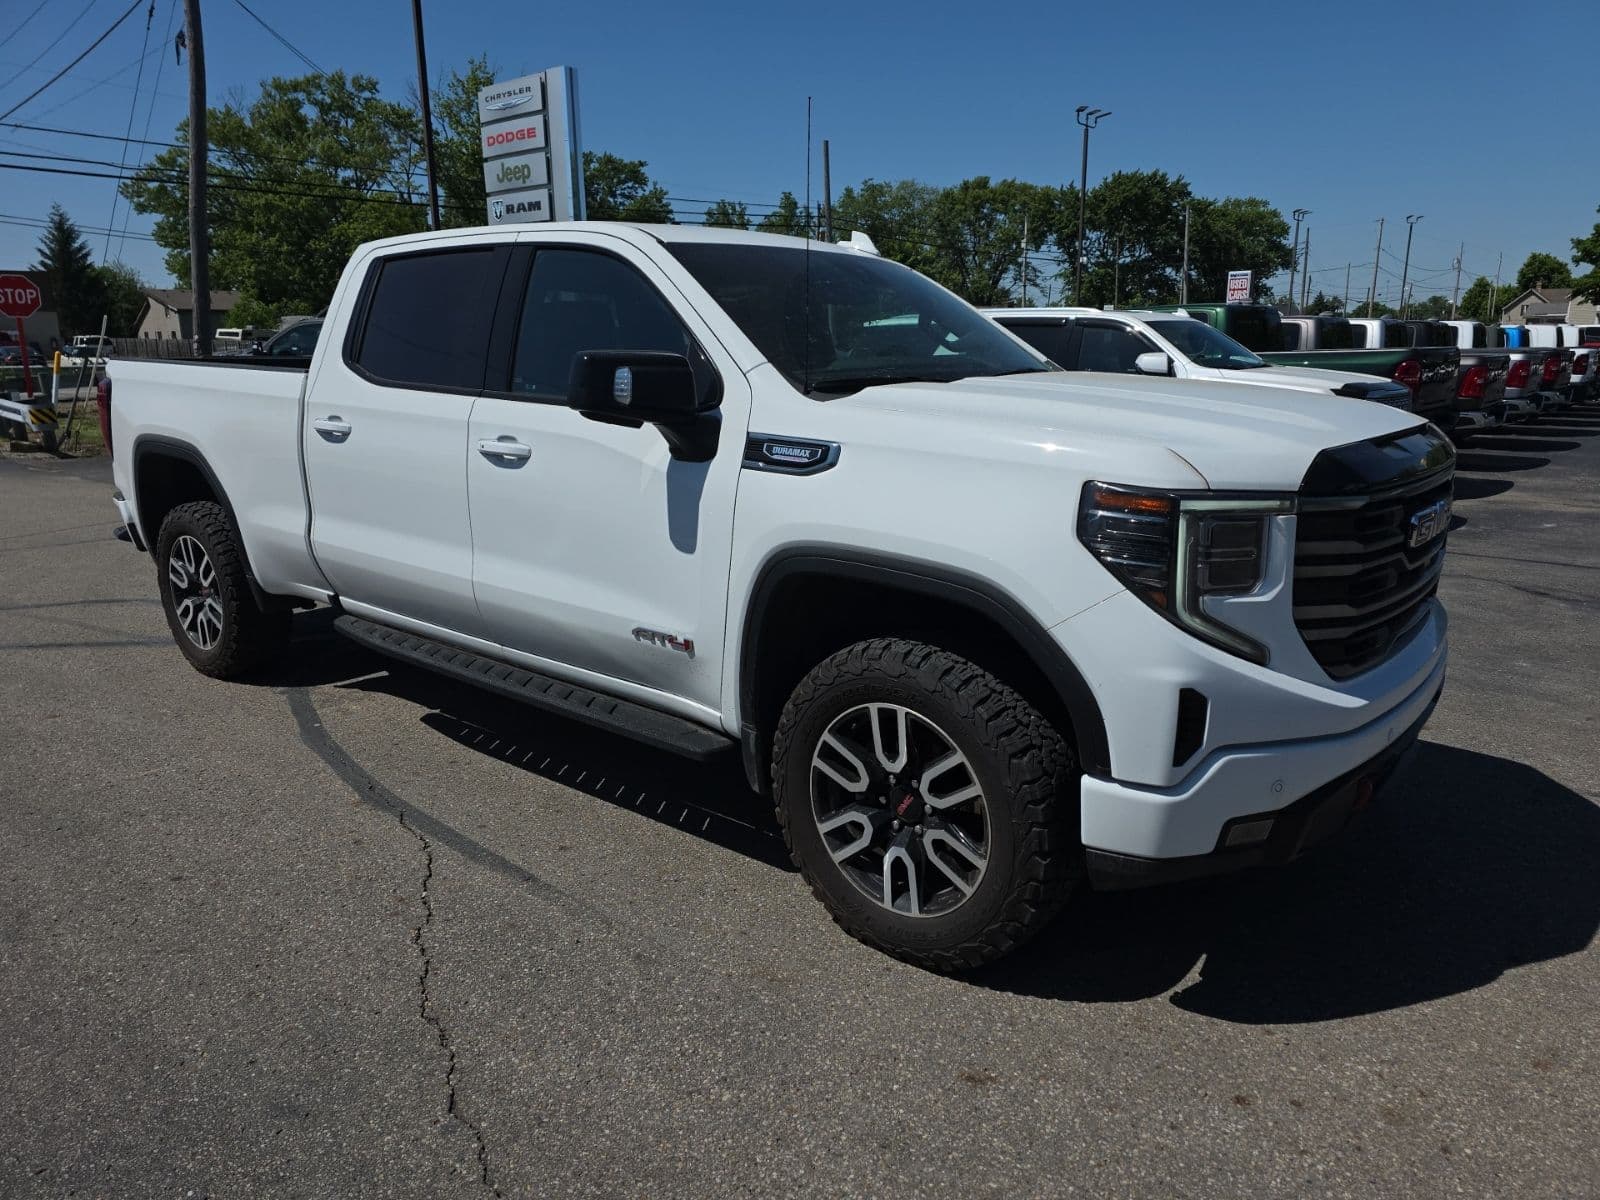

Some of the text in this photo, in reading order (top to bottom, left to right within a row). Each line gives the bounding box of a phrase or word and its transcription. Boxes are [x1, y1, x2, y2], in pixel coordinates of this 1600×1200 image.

[485, 86, 532, 103] CHRYSLER
[487, 127, 537, 147] DODGE
[496, 162, 531, 184] Jeep
[505, 200, 542, 215] RAM
[1230, 279, 1248, 289] USED
[772, 446, 812, 458] DURAMAX
